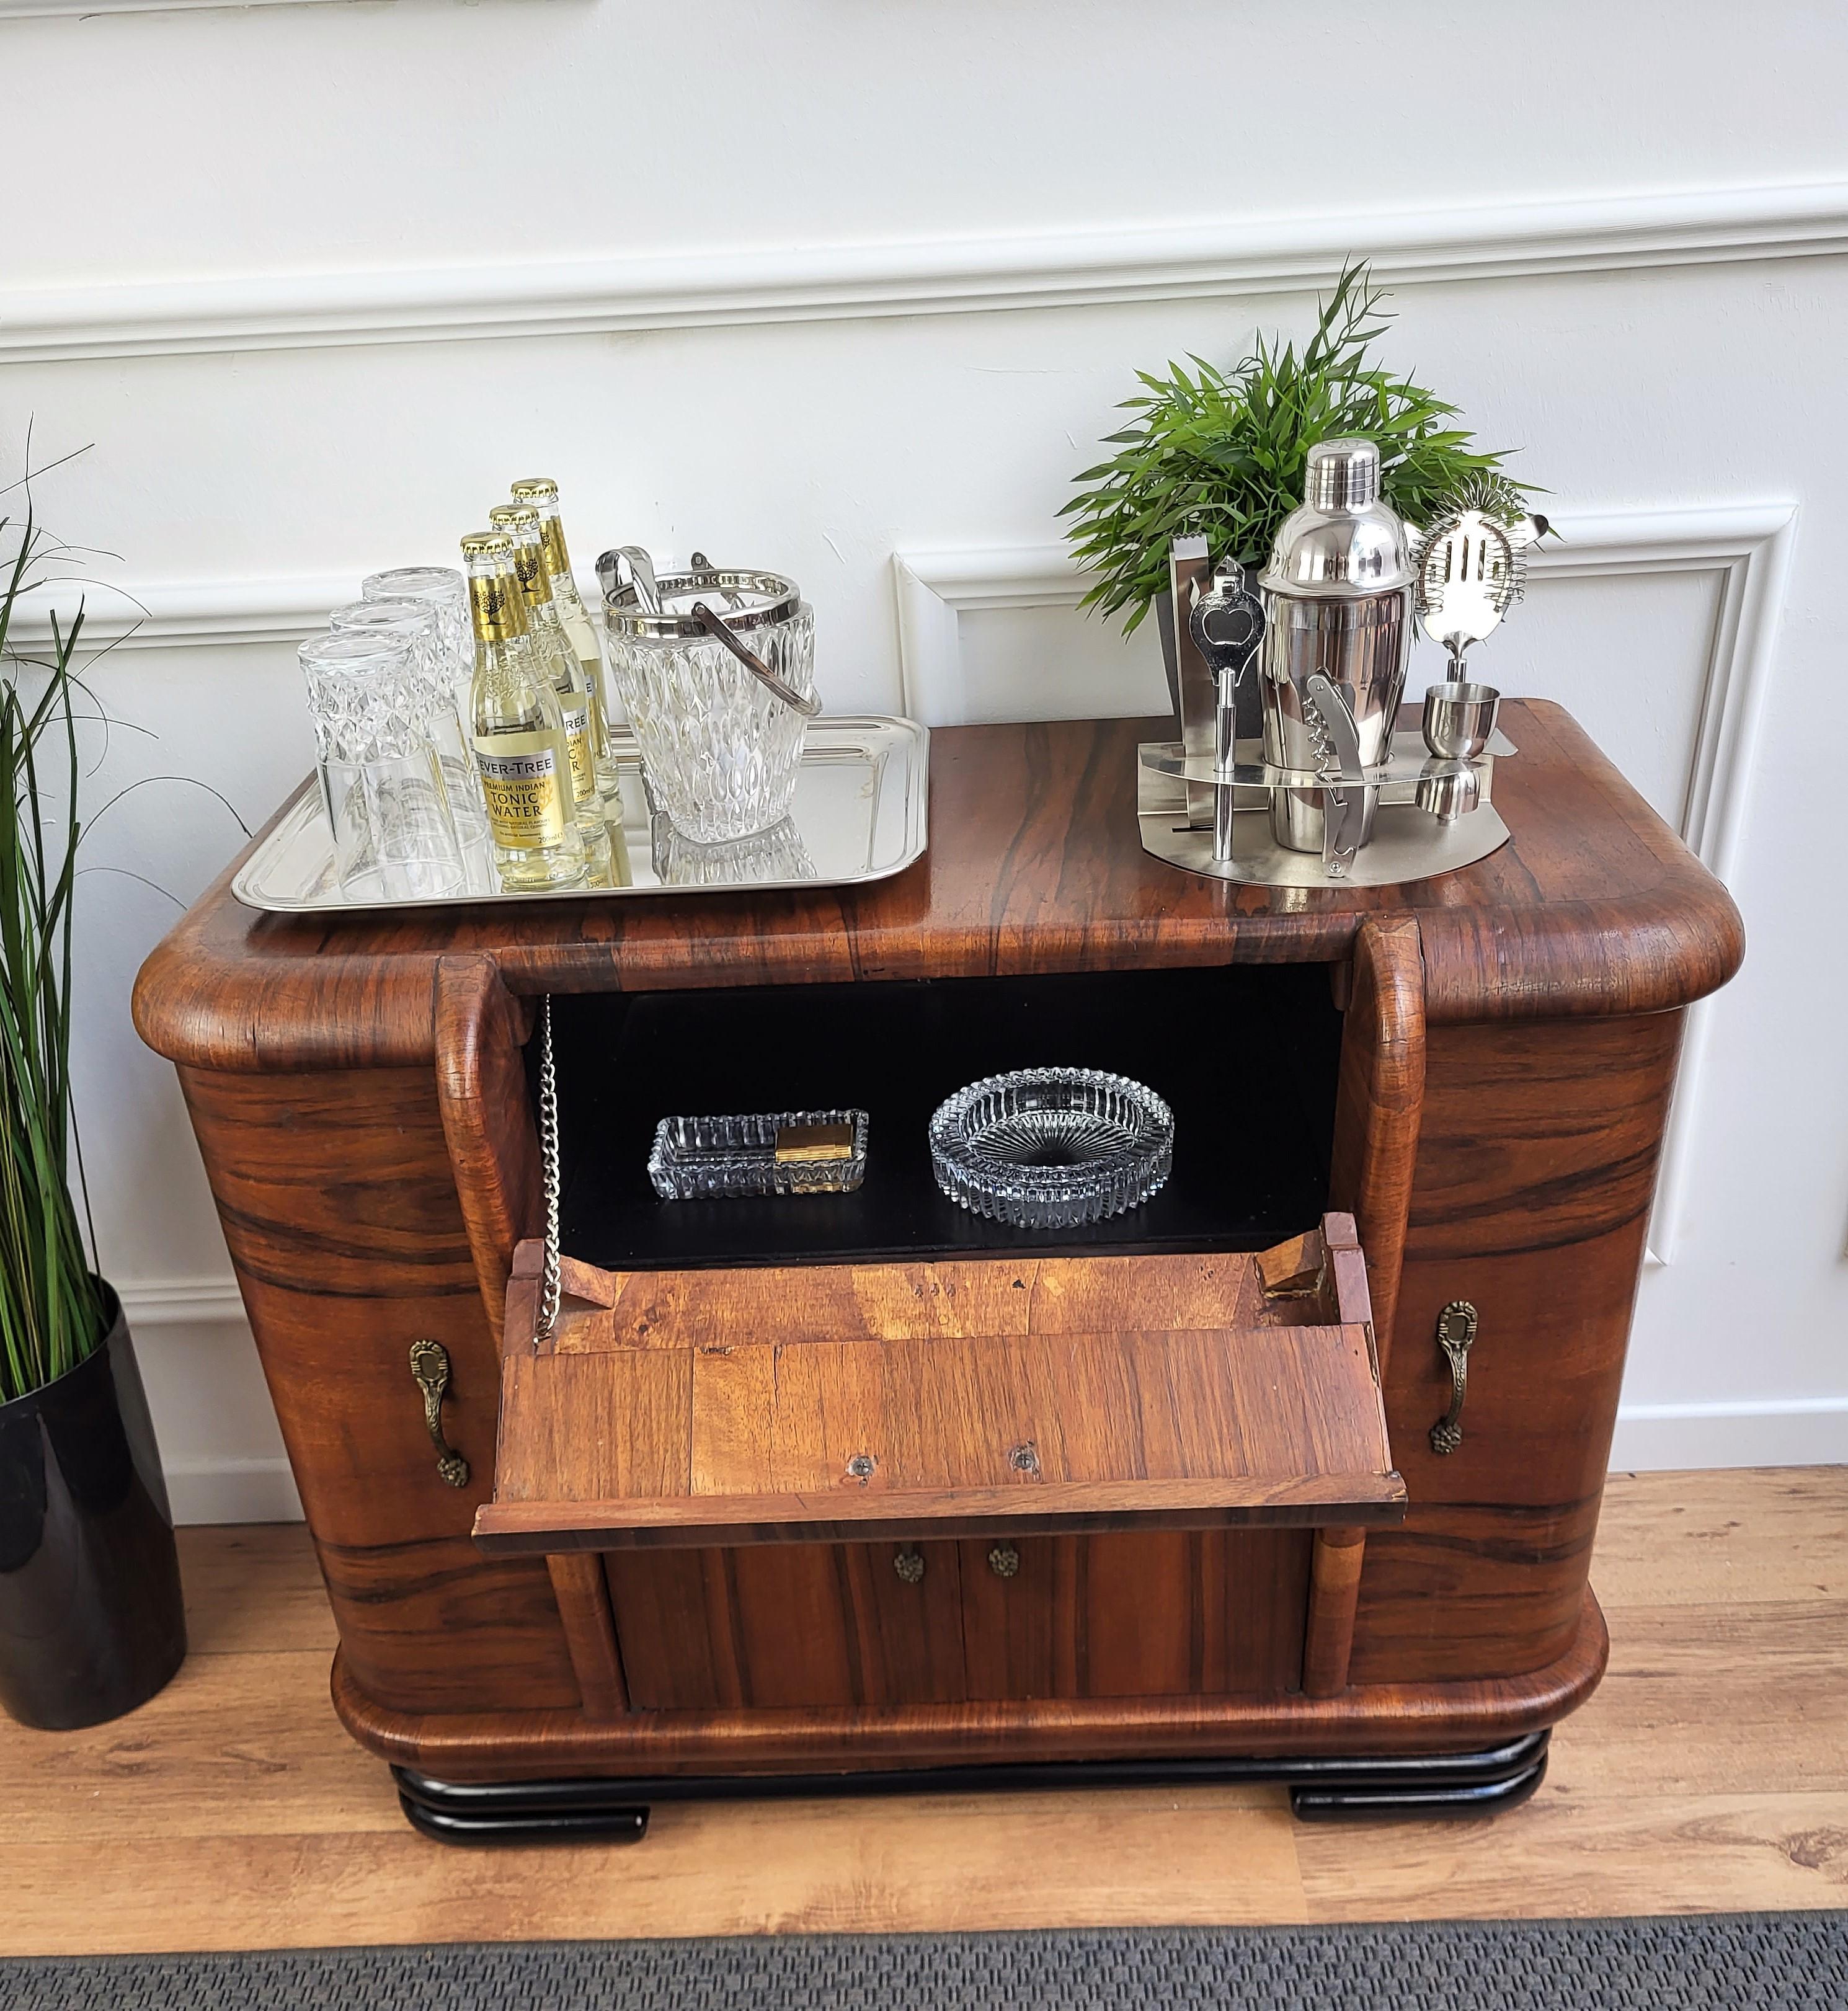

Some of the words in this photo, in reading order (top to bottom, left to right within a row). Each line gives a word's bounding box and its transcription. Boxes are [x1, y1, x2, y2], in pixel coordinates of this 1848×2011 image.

[515, 781, 546, 792] INDIAN
[491, 791, 538, 805] TONIC
[492, 804, 543, 818] WATER
